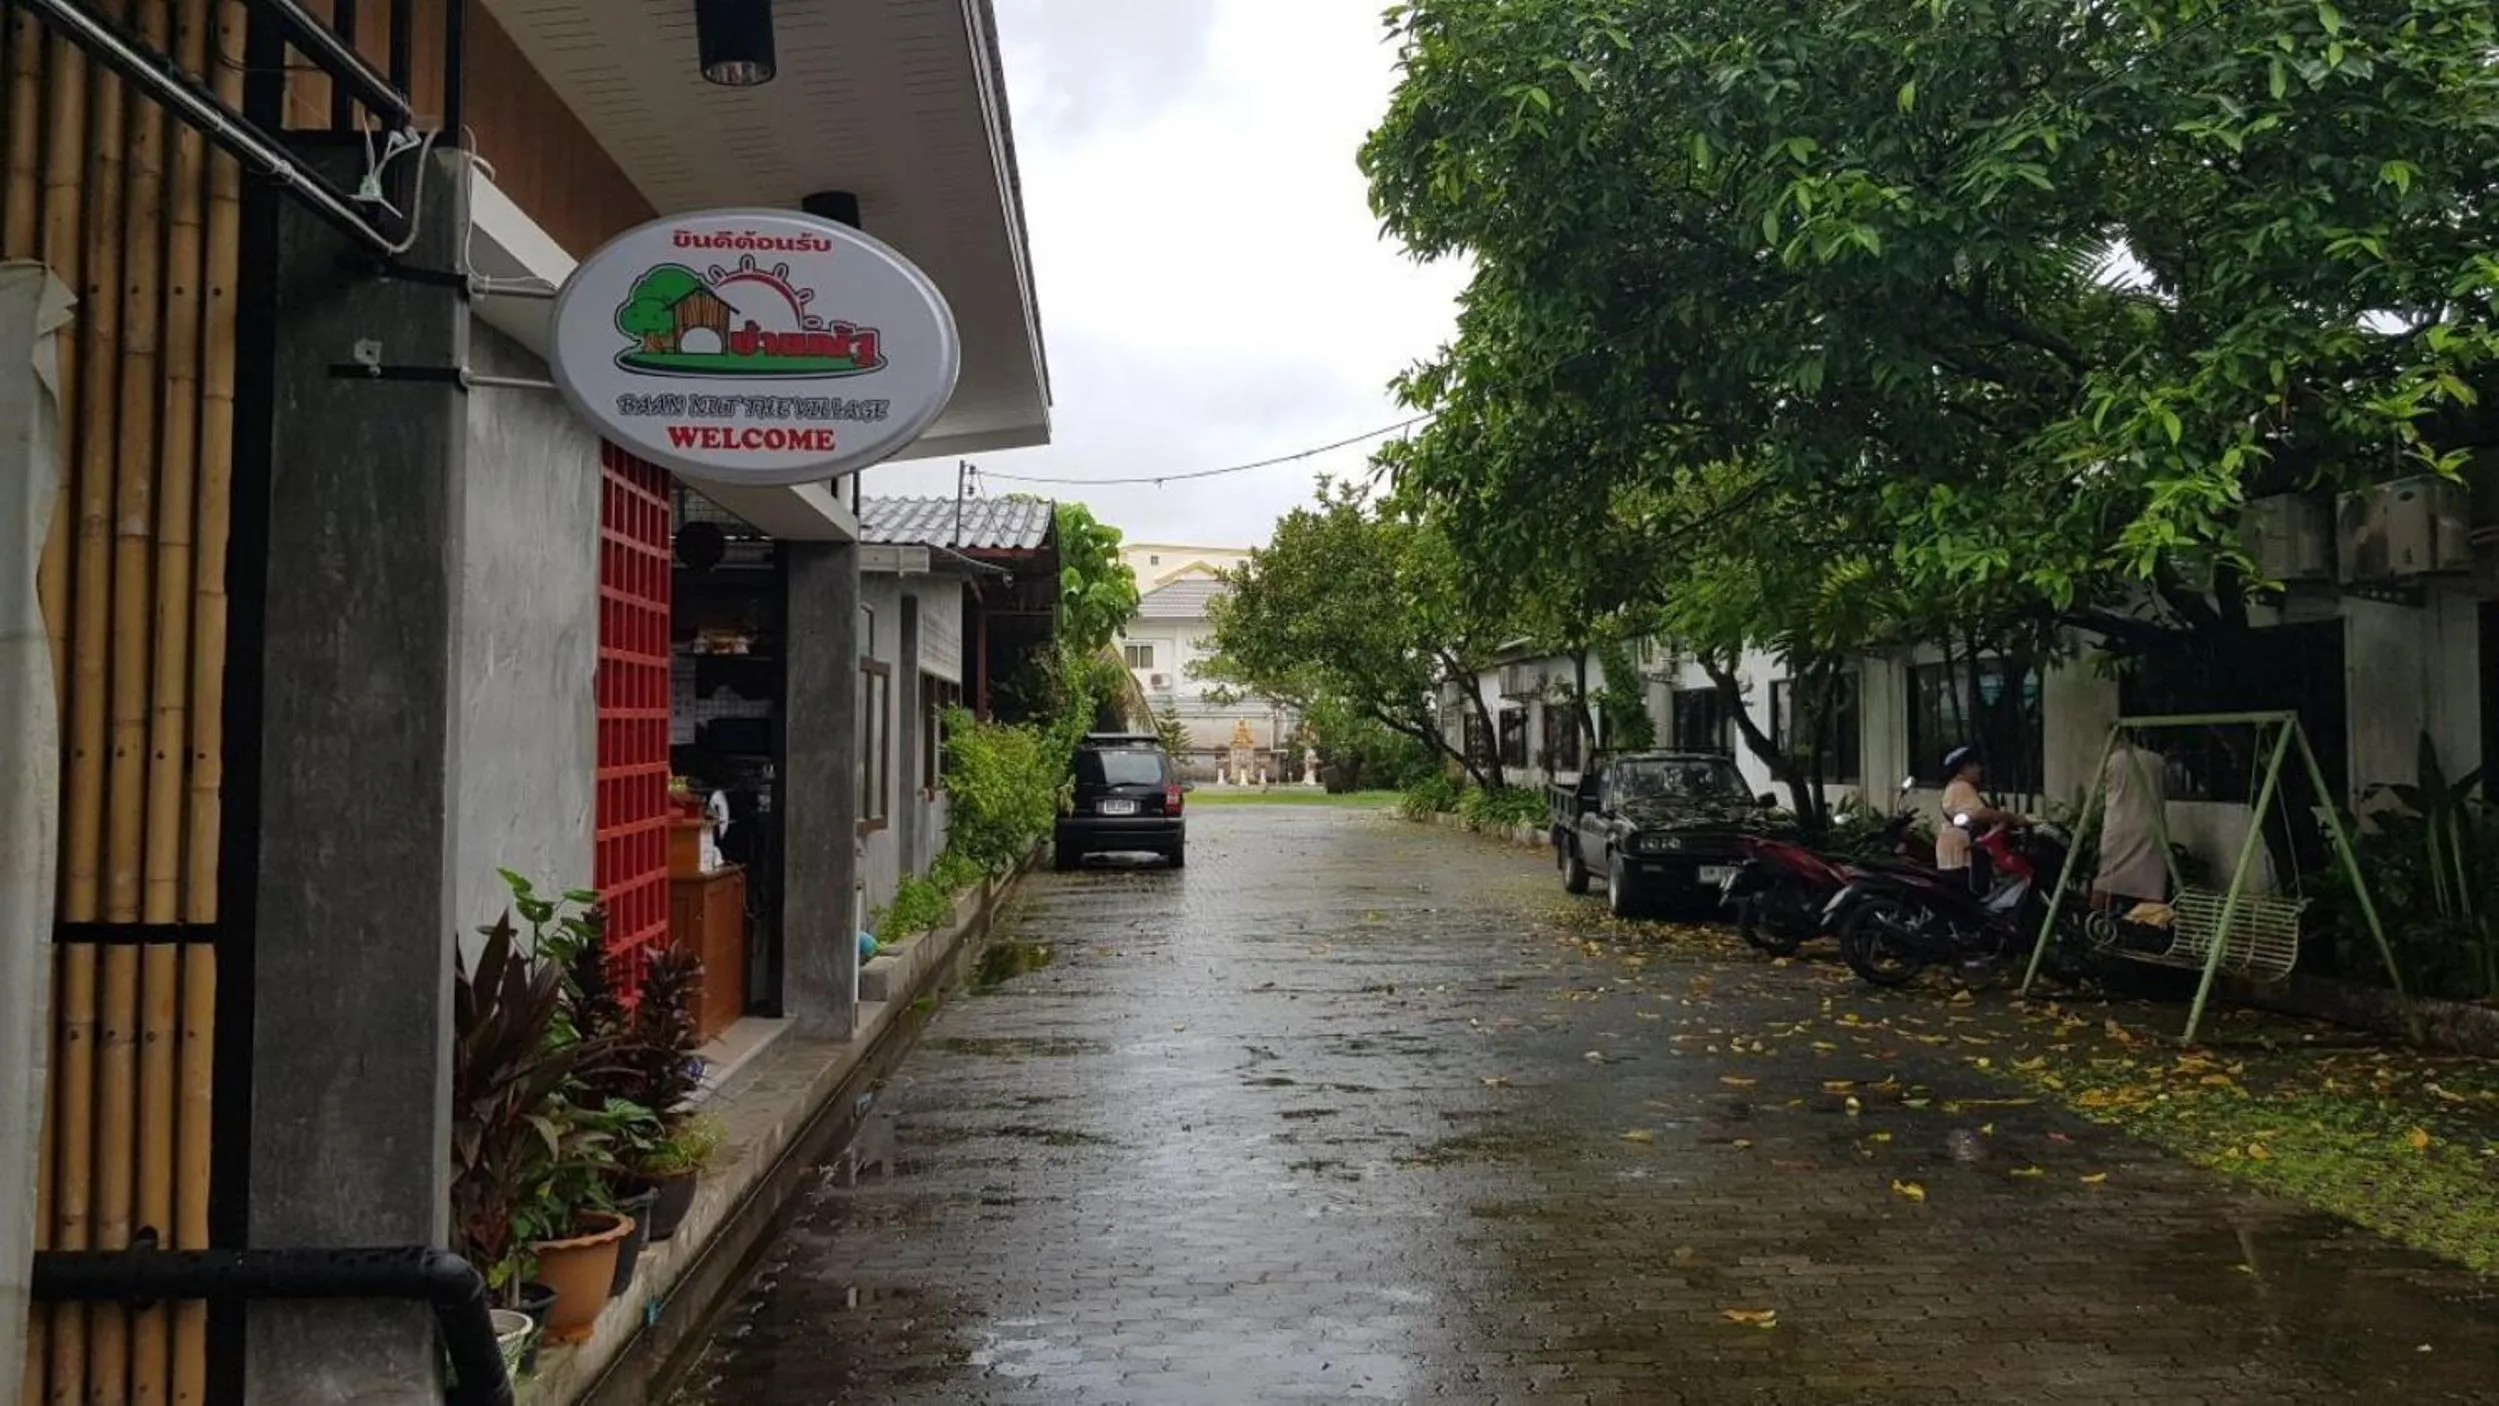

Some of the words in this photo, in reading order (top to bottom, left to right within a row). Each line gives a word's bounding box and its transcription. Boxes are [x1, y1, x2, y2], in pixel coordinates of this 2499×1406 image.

[616, 393, 687, 417] BAAN
[744, 395, 790, 419] THE
[792, 396, 891, 423] VILLAGE
[668, 426, 836, 451] WELCOME
